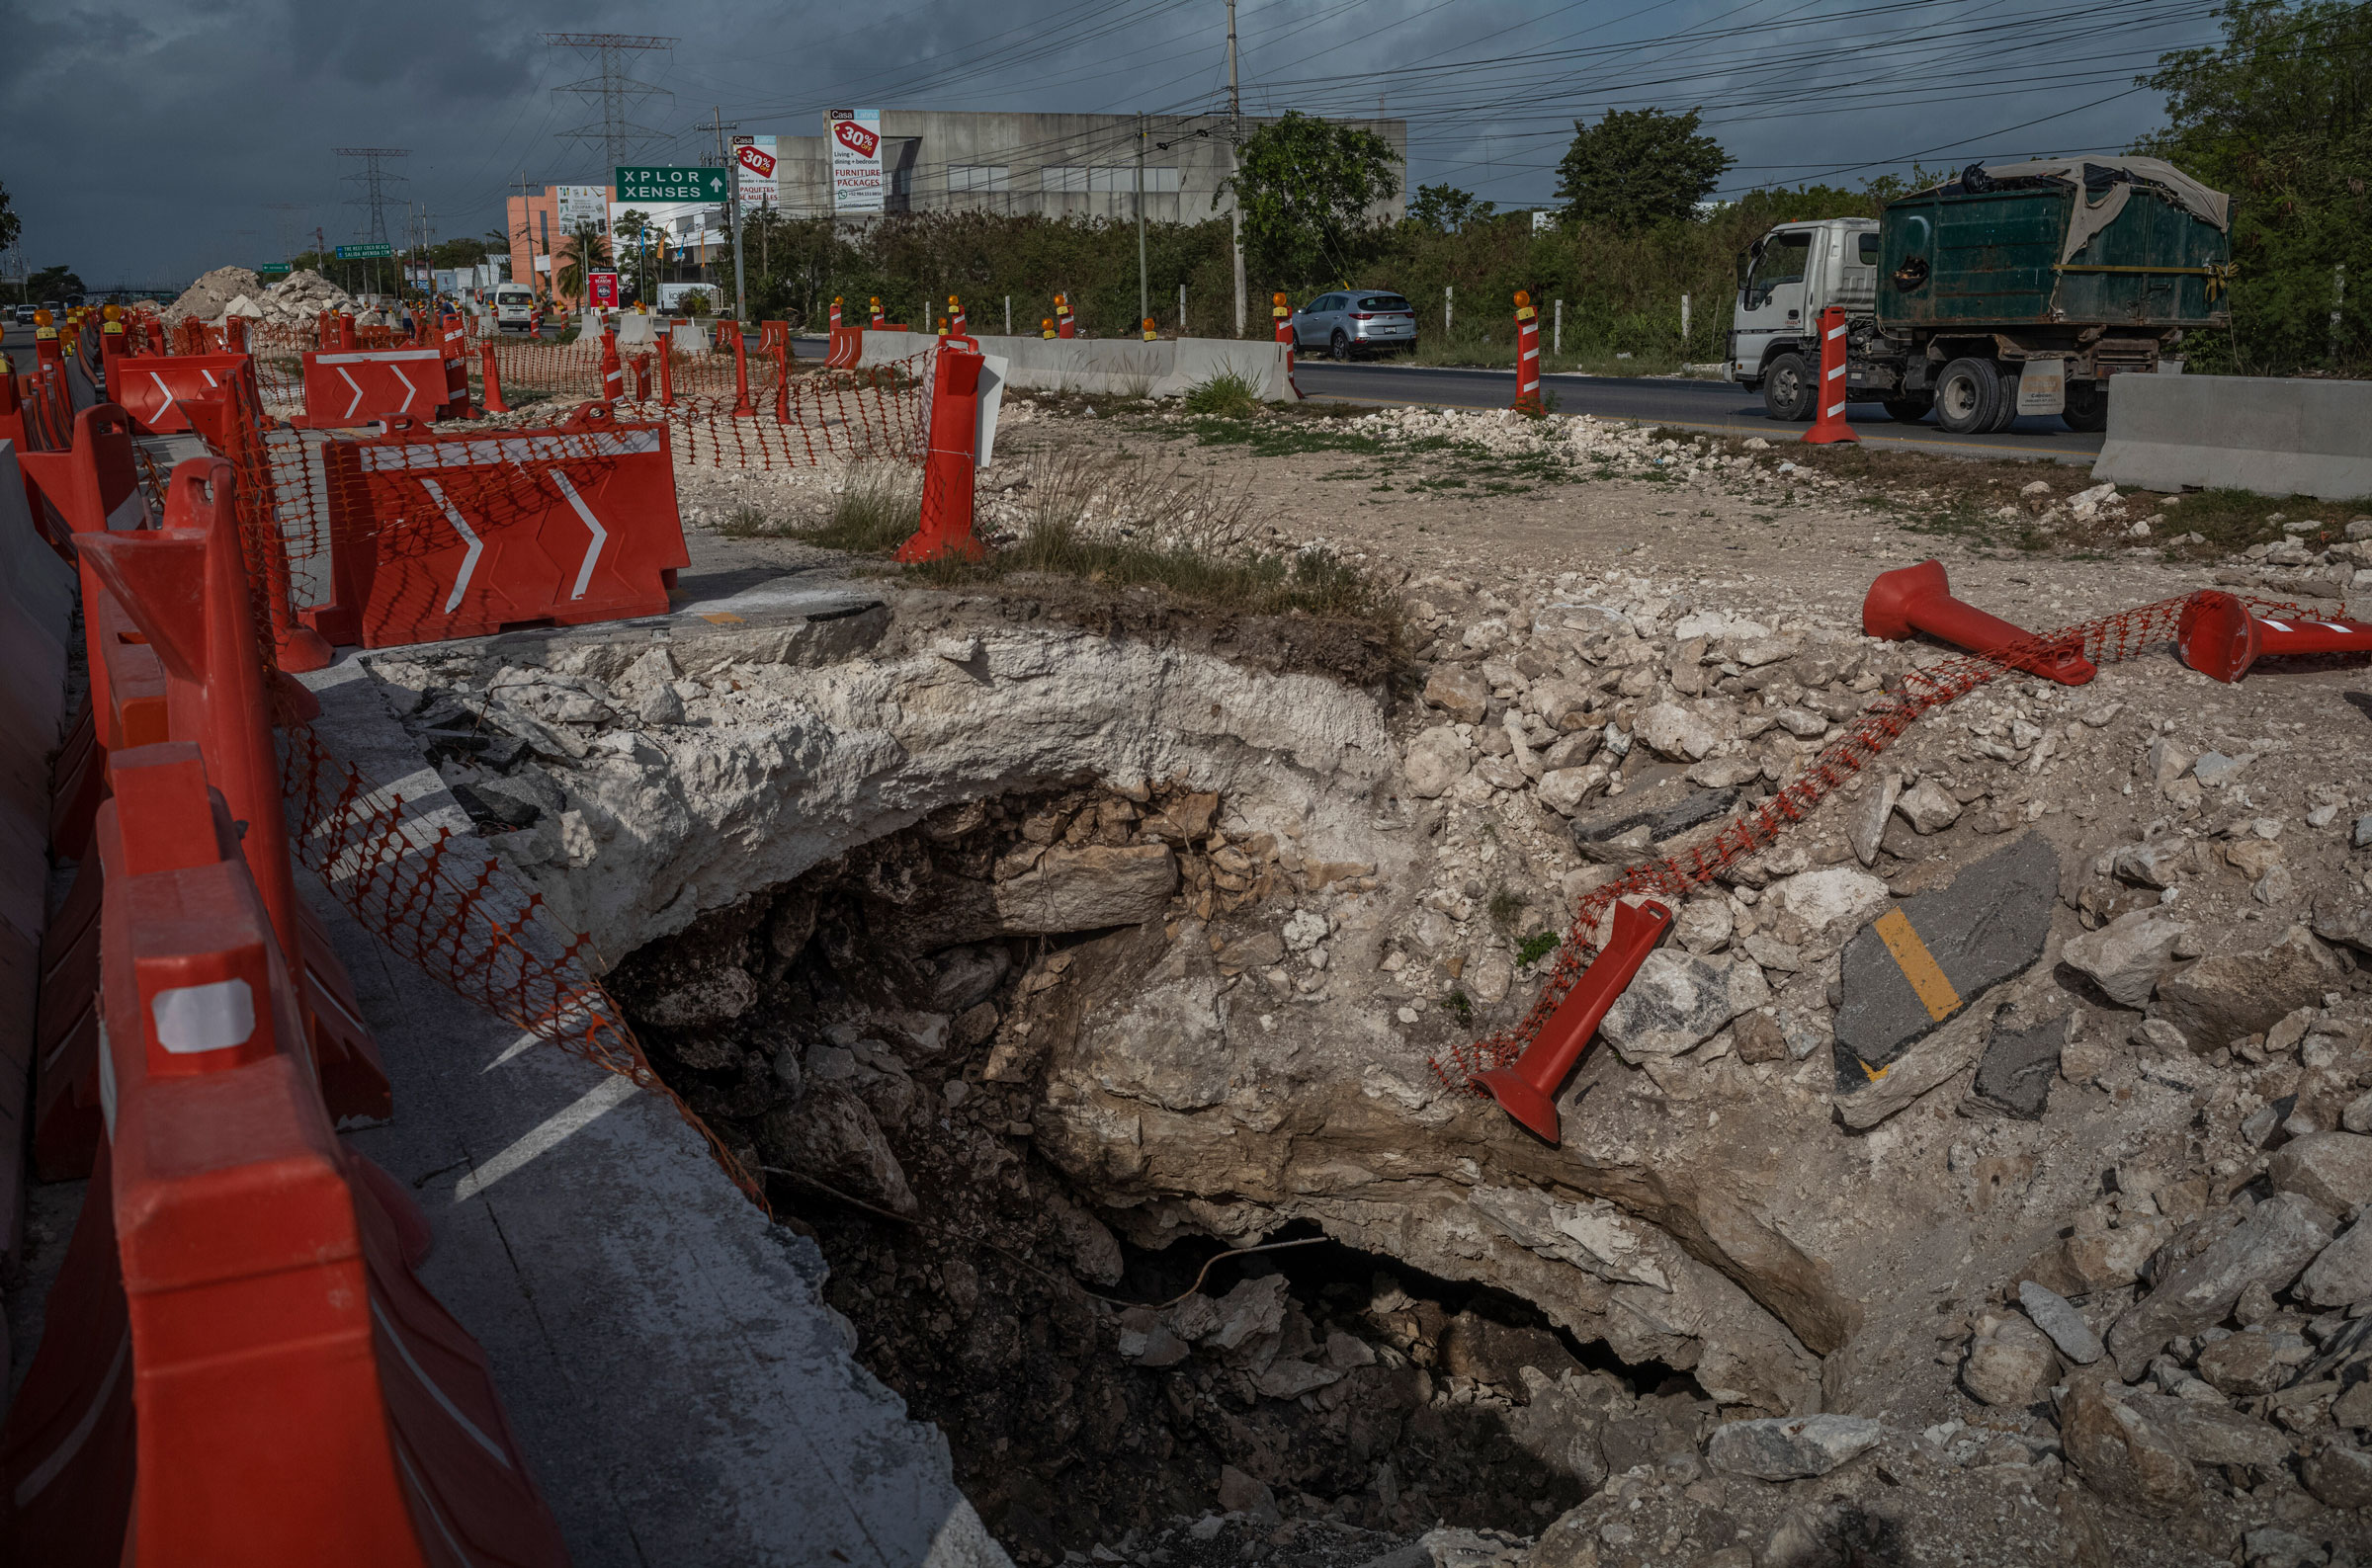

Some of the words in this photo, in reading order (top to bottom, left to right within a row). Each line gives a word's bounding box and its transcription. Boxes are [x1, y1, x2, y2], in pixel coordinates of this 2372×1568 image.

[841, 125, 873, 146] 30%
[861, 143, 873, 152] OFF
[742, 149, 771, 168] 30%
[625, 186, 701, 197] XENSES
